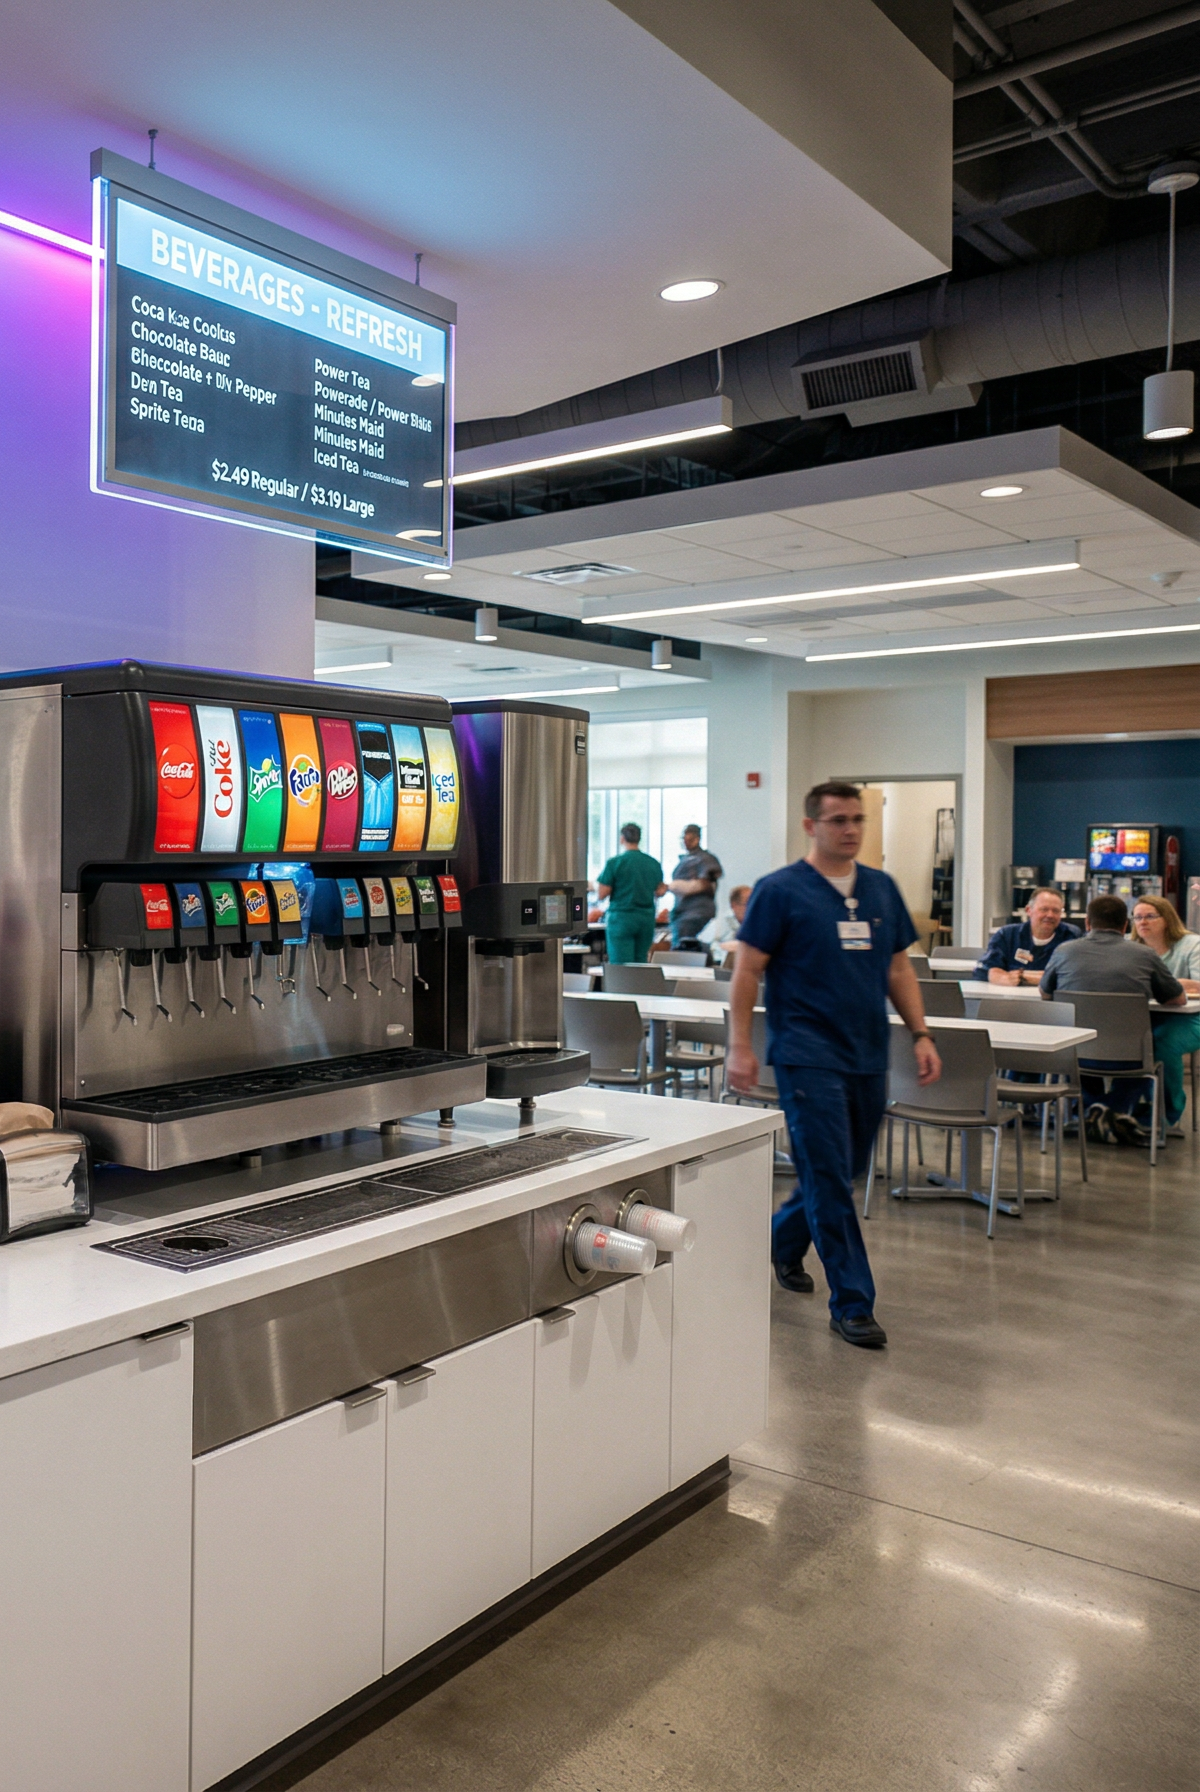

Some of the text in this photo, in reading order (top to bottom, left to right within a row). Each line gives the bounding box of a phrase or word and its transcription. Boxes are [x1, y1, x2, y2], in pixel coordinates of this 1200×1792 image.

[131, 295, 165, 322] Coca
[151, 228, 305, 317] BEVERAGES
[326, 298, 422, 362] REFRESH
[131, 321, 197, 357] Chocolate
[314, 358, 370, 391] Power Tea
[160, 380, 183, 402] Tea
[235, 378, 278, 406] Pepper
[314, 380, 368, 412] Powerade
[377, 401, 409, 425] Power
[130, 397, 171, 424] Sprite
[314, 403, 384, 438] Minutes Maid
[314, 447, 359, 475] Iced Tea
[359, 438, 384, 460] Maid
[211, 458, 249, 487] $2.49
[251, 470, 300, 498] Regular
[310, 483, 341, 509] $3.19
[343, 494, 375, 518] Large
[214, 739, 233, 818] Coke
[431, 772, 455, 788] Iced
[435, 787, 455, 803] Tea
